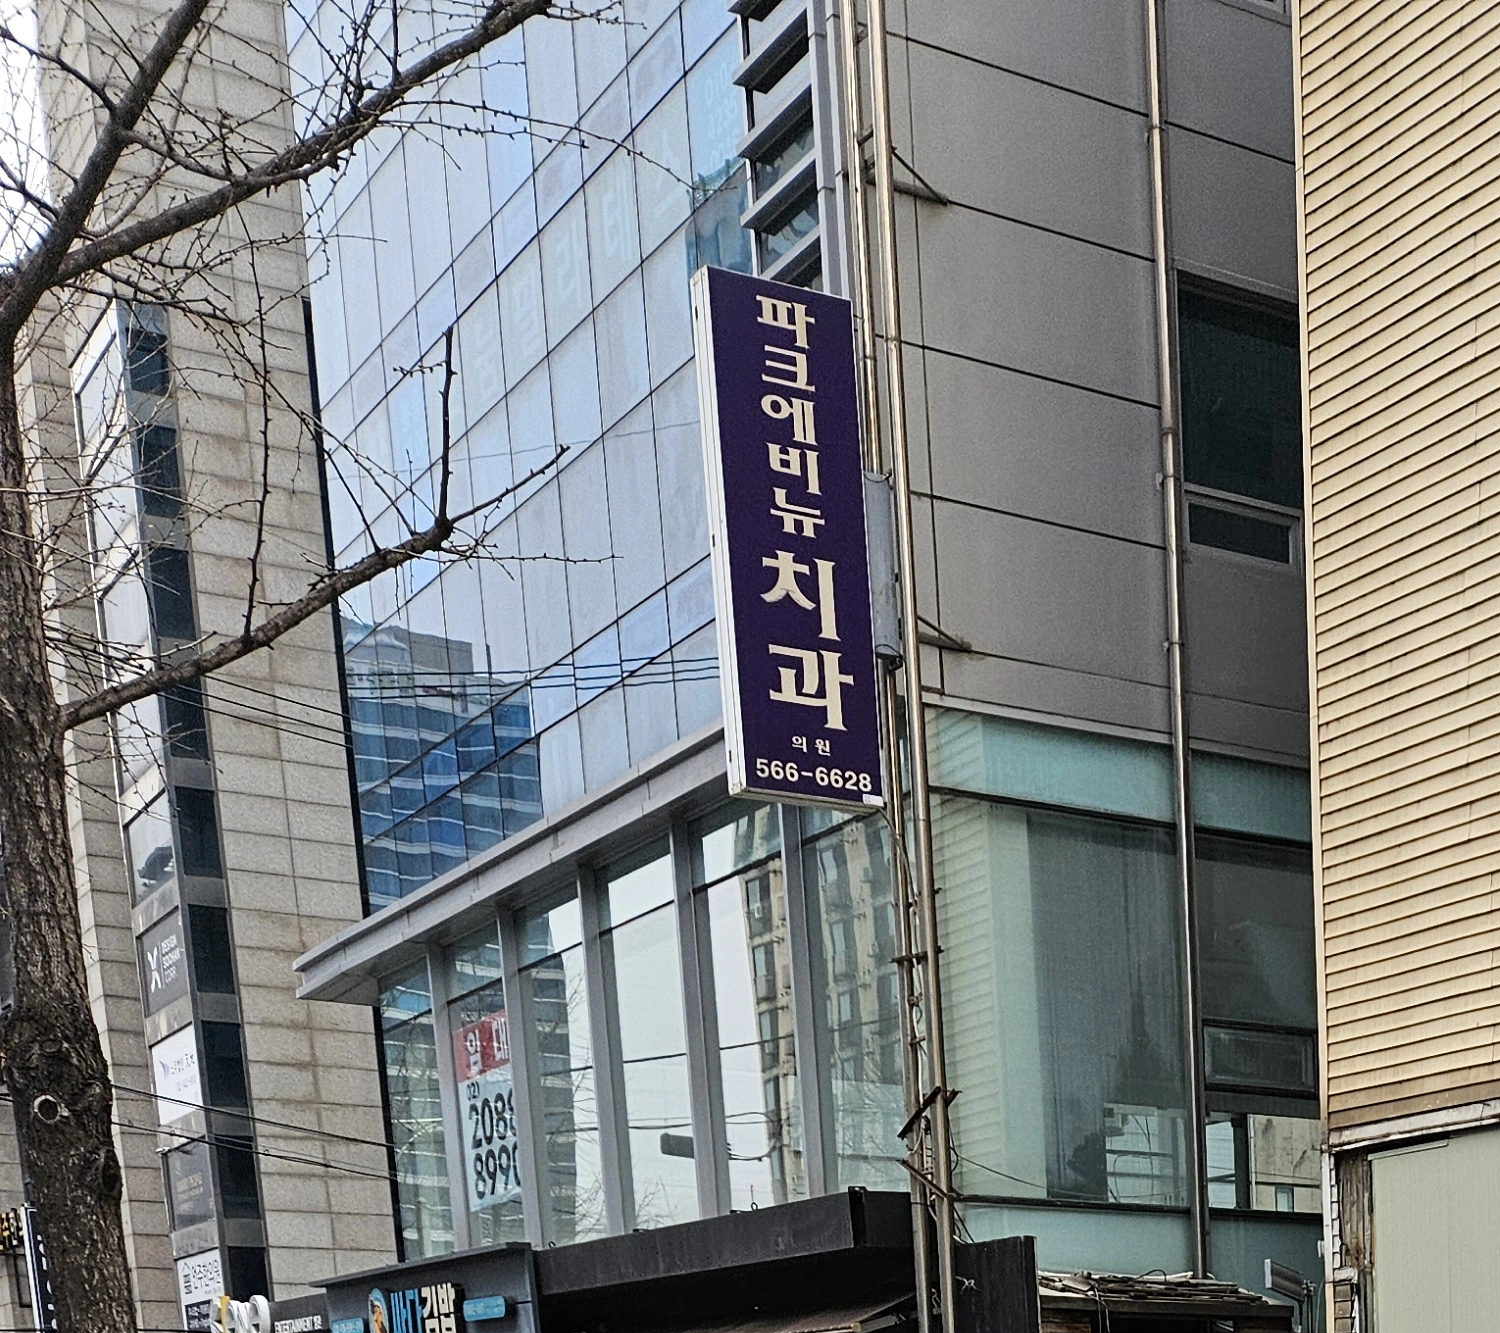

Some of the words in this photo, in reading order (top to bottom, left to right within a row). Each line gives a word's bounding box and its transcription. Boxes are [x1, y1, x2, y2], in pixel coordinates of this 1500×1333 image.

[756, 294, 825, 538] 파크에비뉴
[760, 550, 854, 731] 치과
[756, 758, 872, 792] 566-6628
[792, 736, 830, 756] 의원
